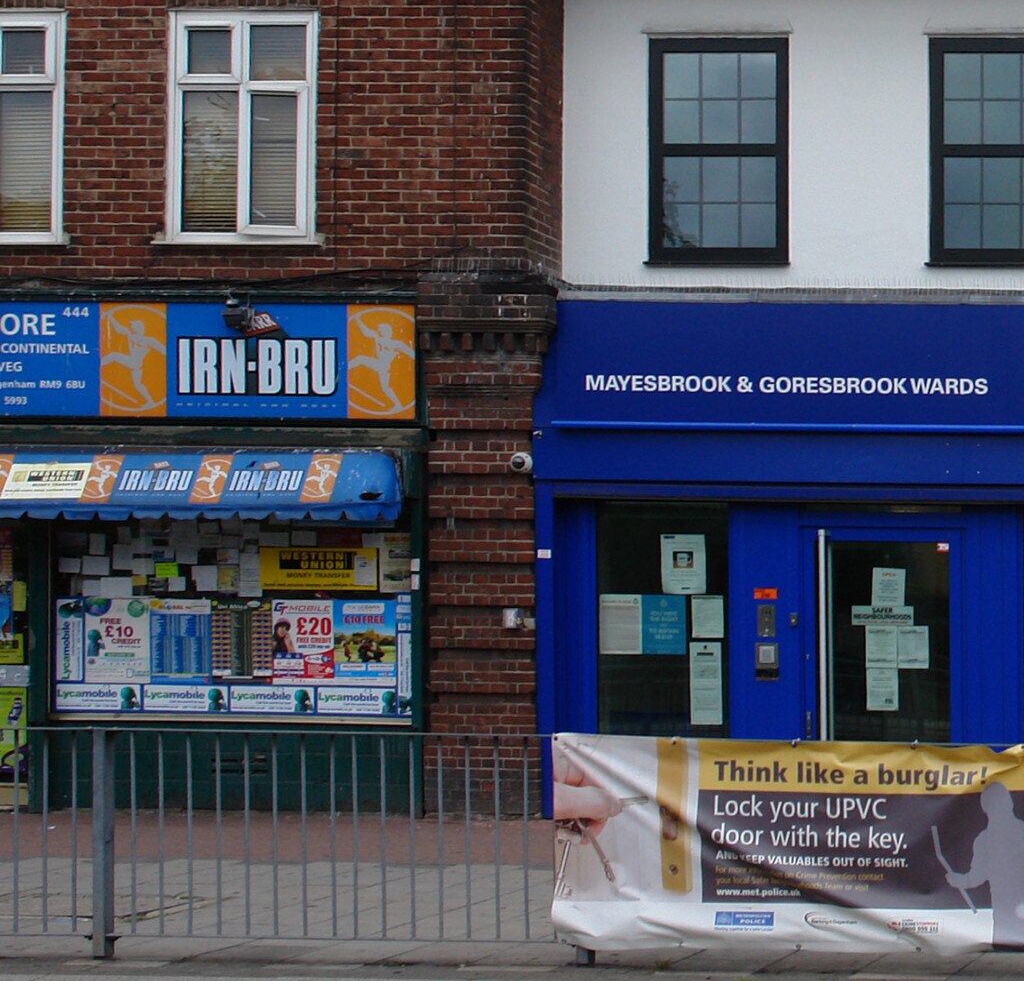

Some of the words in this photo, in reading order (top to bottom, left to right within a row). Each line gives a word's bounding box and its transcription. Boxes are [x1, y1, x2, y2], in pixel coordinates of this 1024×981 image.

[62, 306, 89, 318] 444
[0, 313, 56, 336] ORE
[0, 342, 90, 355] CONTINENTAL
[178, 338, 337, 395] IRN-BRU
[0, 380, 36, 389] enham
[39, 380, 62, 389] RM9
[65, 380, 86, 389] 6BU
[585, 374, 732, 393] MAYESBROOK
[736, 375, 754, 393] &
[759, 376, 908, 395] GORESBROOK
[909, 377, 989, 395] WARDS
[4, 395, 28, 405] 5993
[118, 470, 194, 491] IRN-BRU
[228, 470, 305, 492] IRN-BRU
[281, 551, 344, 560] WESTERN
[300, 560, 344, 569] UNION
[104, 625, 134, 638] £10
[296, 617, 332, 636] £20
[61, 621, 71, 680] Lycamobile
[57, 689, 118, 699] Lycamobile
[144, 690, 206, 700] Lycamobile
[231, 691, 292, 701] Lycamobile
[318, 692, 379, 703] Lycamobile
[714, 760, 788, 783] Think
[797, 762, 844, 785] like
[853, 769, 869, 785] a
[878, 763, 988, 791] burglar!
[714, 794, 763, 817] Lock
[770, 799, 819, 823] your
[826, 798, 888, 820] UPVC
[711, 823, 764, 846] door
[770, 825, 818, 848] with
[825, 826, 861, 848] the
[868, 827, 908, 855] key.
[767, 854, 830, 867] VALUABLES
[832, 856, 855, 867] OUT
[857, 857, 872, 867] OF
[874, 857, 909, 868] SIGHT.
[716, 888, 801, 898] www.met.police.uk
